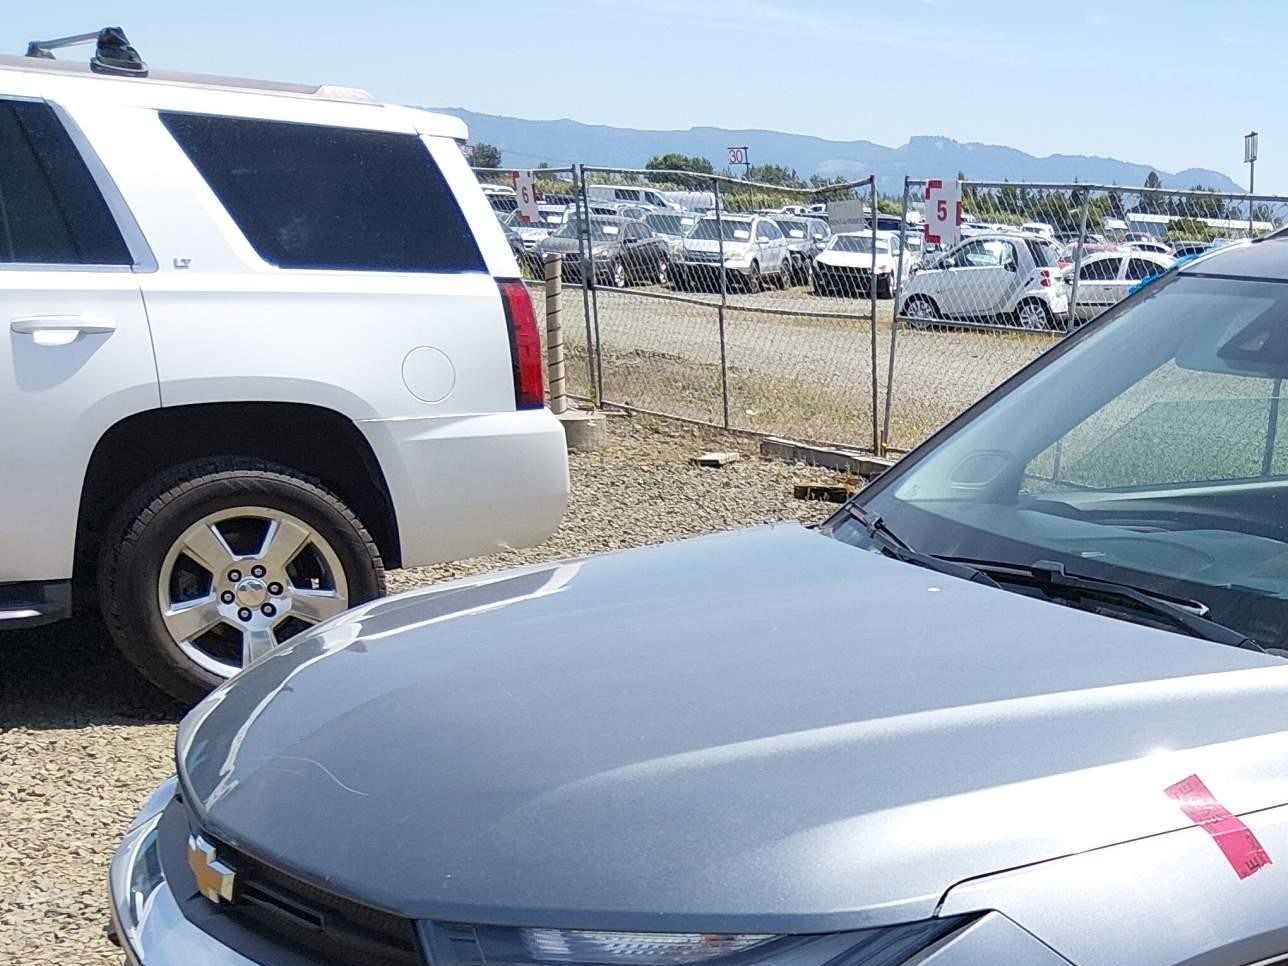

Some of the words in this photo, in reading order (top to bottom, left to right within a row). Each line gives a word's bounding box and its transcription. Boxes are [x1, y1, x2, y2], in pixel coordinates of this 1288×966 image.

[729, 149, 743, 163] 30
[521, 187, 529, 204] 6
[937, 200, 948, 221] 5
